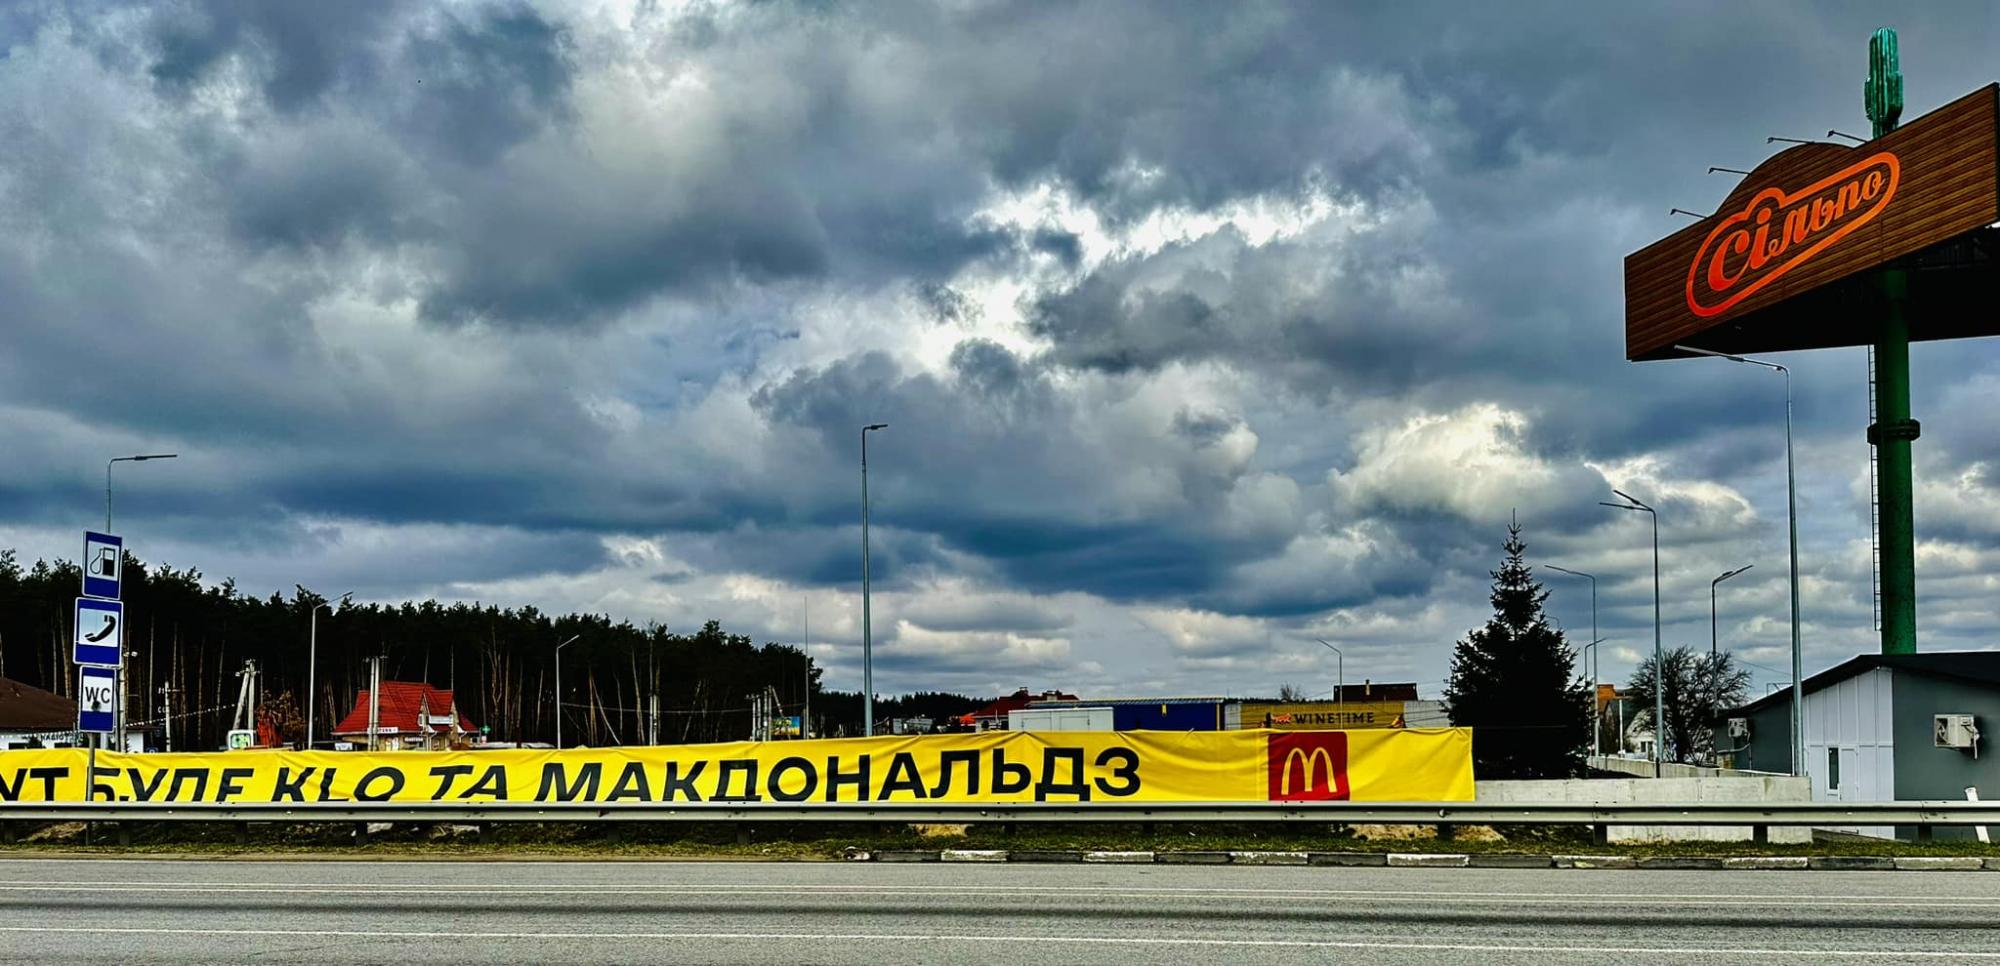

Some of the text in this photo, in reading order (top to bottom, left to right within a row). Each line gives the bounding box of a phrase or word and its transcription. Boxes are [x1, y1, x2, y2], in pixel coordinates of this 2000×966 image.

[1707, 170, 1886, 291] Сільпо
[85, 686, 111, 704] WC
[1294, 712, 1375, 725] WINETIME
[429, 765, 508, 801] ТА
[534, 747, 1141, 802] МАКДОНАЛЬДЗ
